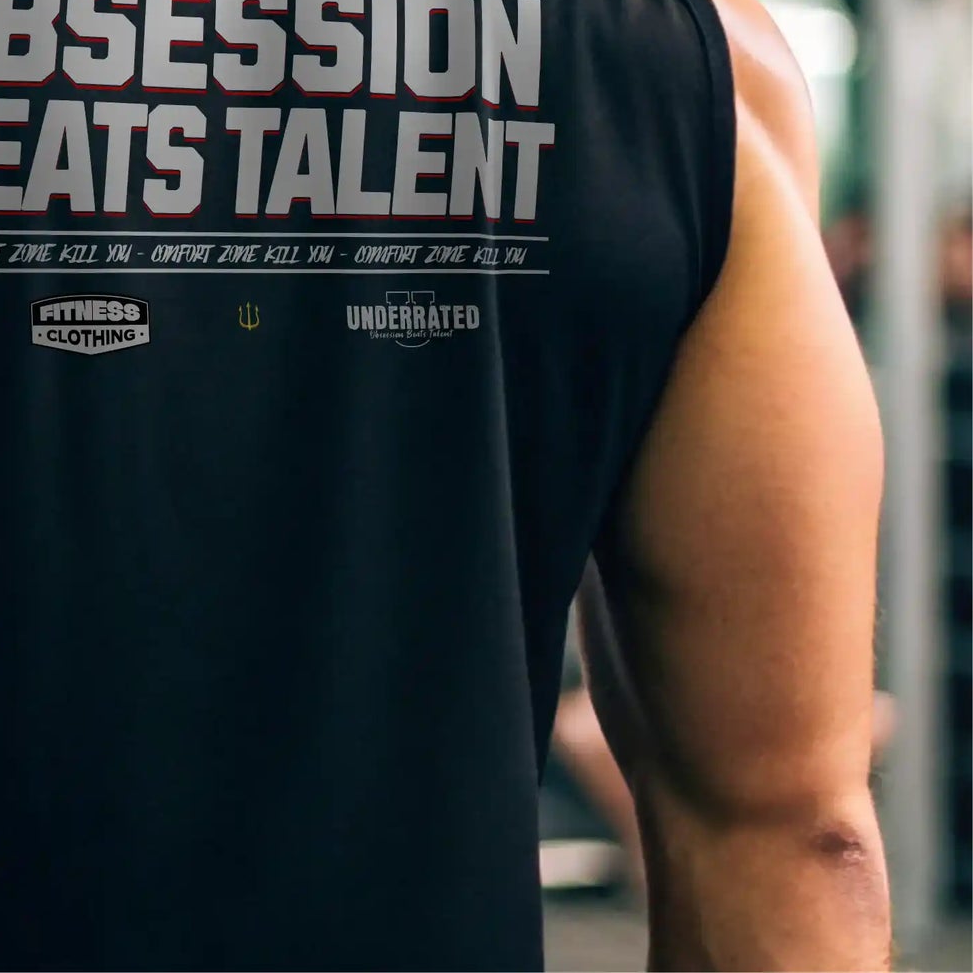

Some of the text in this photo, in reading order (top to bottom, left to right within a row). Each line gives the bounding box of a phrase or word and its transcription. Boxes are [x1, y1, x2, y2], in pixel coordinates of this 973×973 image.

[225, 107, 555, 223] TALENT
[8, 243, 56, 264] ZONE
[58, 244, 100, 264] KILL
[105, 244, 132, 264] YOU
[217, 244, 261, 264] ZONE
[264, 245, 302, 264] KILL
[308, 244, 335, 264] YOU
[354, 245, 424, 265] COMFORT
[424, 245, 472, 265] ZONE
[473, 245, 500, 266] KILL
[503, 247, 529, 265] YOU
[39, 299, 141, 322] FITNESS
[346, 305, 480, 330] UNDERRATED
[47, 329, 136, 347] CLOTHING
